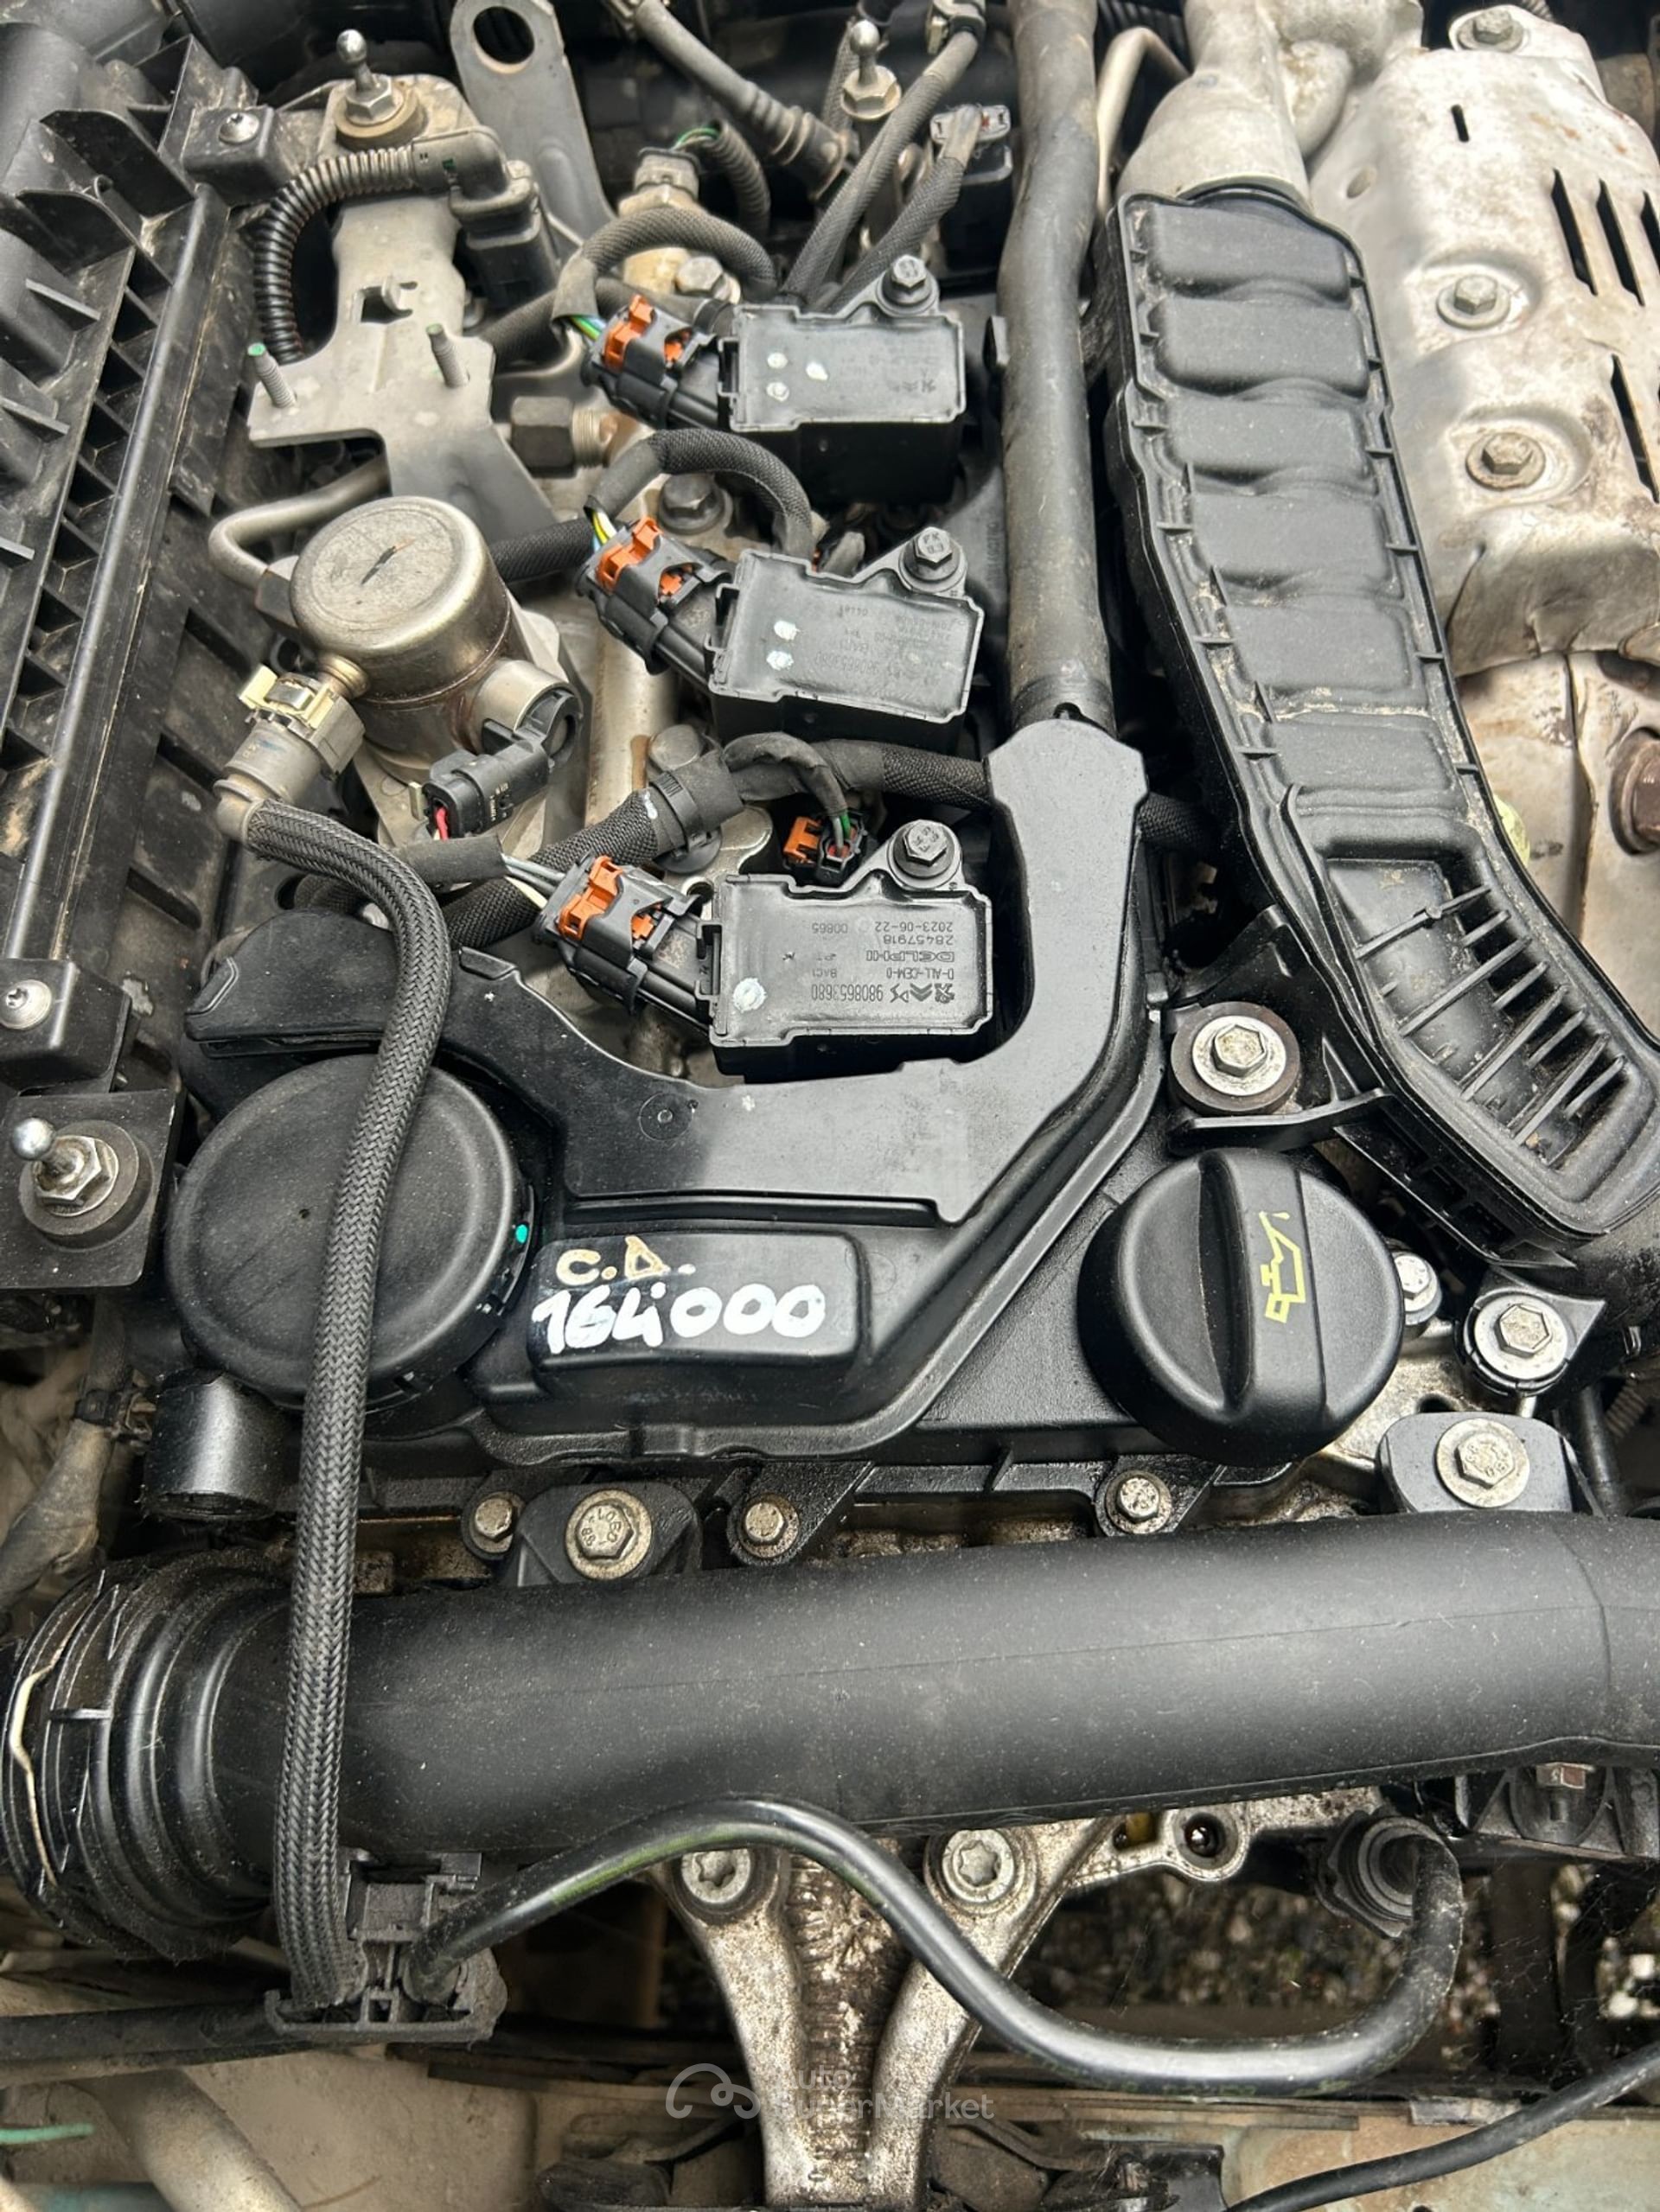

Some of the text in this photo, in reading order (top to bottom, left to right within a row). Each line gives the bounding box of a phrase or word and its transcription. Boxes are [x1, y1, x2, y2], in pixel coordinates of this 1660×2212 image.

[875, 921, 953, 932] 2023-06-22
[883, 934, 954, 945] 28457918
[866, 950, 954, 962] DELPHI
[811, 984, 883, 1002] 9808653680
